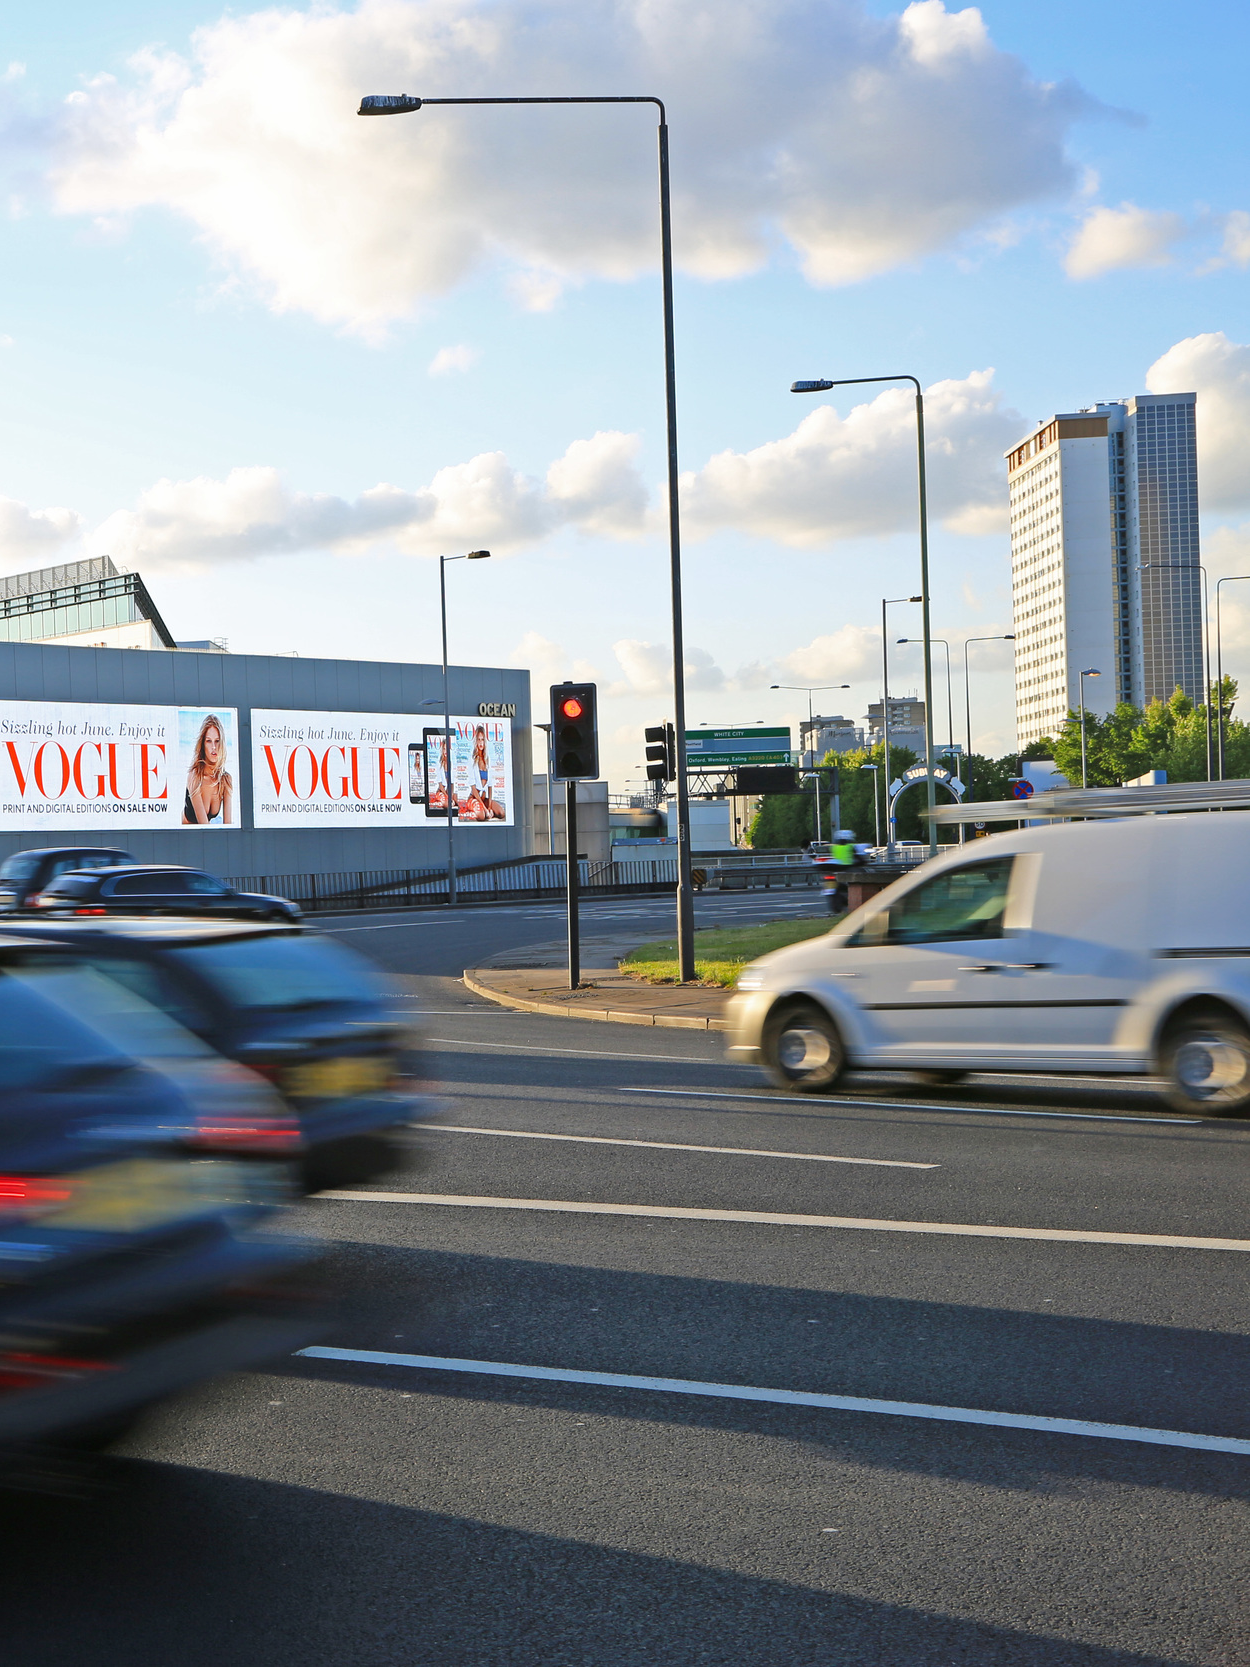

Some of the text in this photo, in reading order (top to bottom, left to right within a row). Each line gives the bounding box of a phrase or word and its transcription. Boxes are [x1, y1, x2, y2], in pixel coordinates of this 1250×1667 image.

[479, 702, 516, 717] OCEAN
[0, 719, 165, 741] Sizzling hot June. Enjoy it
[259, 725, 400, 744] Sizzling hot June. Enjoy it
[1, 740, 168, 800] VOGUE
[260, 744, 402, 800] VOGUE
[906, 767, 948, 780] SUBAY
[3, 803, 168, 814] PRINT AND DIGITAL EDITIONS ON SALE NOW
[261, 803, 402, 813] PRINT AND DIGITAL EDITIONS ON SALE NOW
